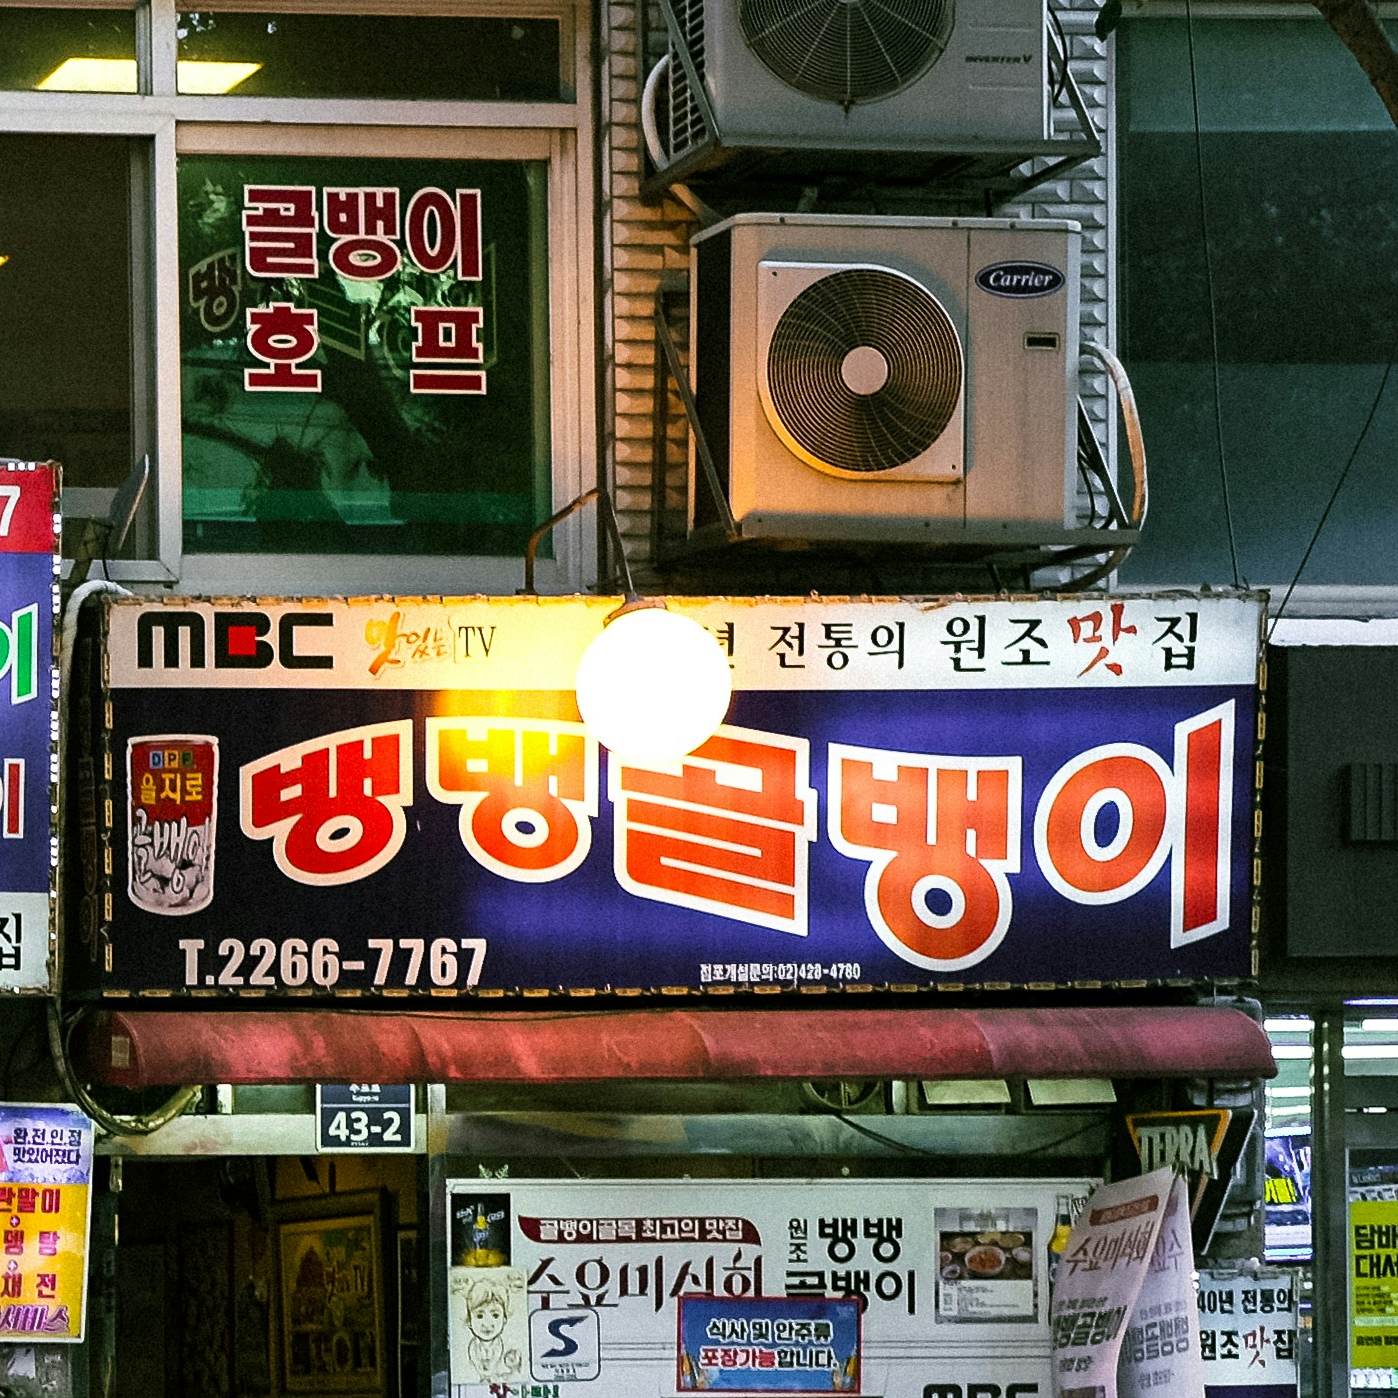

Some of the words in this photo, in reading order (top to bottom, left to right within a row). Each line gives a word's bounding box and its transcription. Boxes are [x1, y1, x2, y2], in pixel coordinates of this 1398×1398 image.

[243, 184, 484, 282] 골뱅이
[989, 270, 1053, 288] Carrier
[136, 610, 335, 669] MBC
[458, 625, 497, 658] TV
[768, 620, 907, 670] 전통의
[140, 772, 203, 803] 을지로
[178, 937, 488, 987] T.2266-7767
[327, 1110, 403, 1143] 43-2
[642, 1218, 700, 1240] 최고의
[705, 1218, 743, 1240] 맛집
[818, 1216, 904, 1263] 뱅뱅
[707, 1318, 748, 1343] 식사
[751, 1318, 772, 1344] 및
